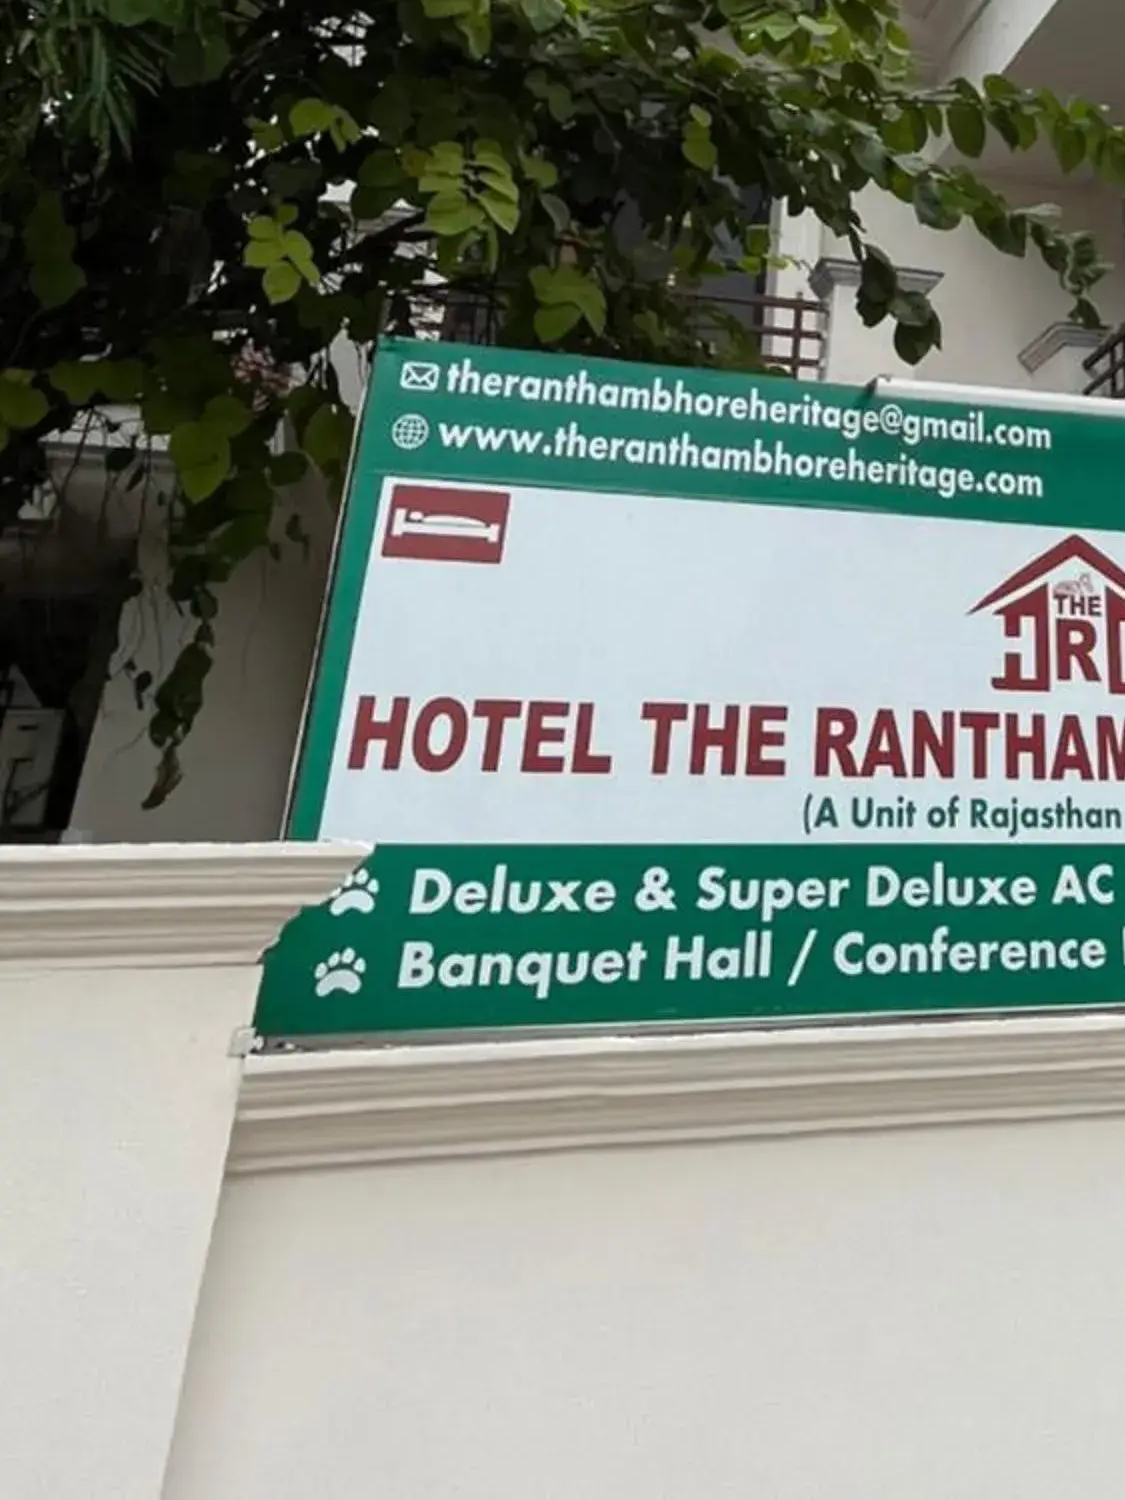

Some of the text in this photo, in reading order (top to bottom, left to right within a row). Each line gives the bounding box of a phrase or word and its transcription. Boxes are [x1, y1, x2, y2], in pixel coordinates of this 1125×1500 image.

[447, 358, 1052, 449] theranthambhoreheritage@gmail.com
[439, 421, 1044, 498] www.theranthambhoreheritage.com
[1052, 593, 1103, 617] THE
[347, 695, 612, 774] HOTEL
[642, 702, 789, 776] THE
[803, 793, 840, 835] (A
[851, 795, 917, 829] Unit
[926, 794, 960, 829] of
[970, 795, 1122, 838] Rajasthan
[409, 865, 617, 914] Deluxe
[634, 866, 677, 911] &
[696, 867, 850, 922] Super
[866, 861, 1037, 907] Deluxe
[1051, 864, 1115, 904] AC
[398, 940, 648, 999] Banquet
[664, 930, 773, 980] Hall
[787, 929, 818, 986] /
[833, 925, 1107, 975] Conference
